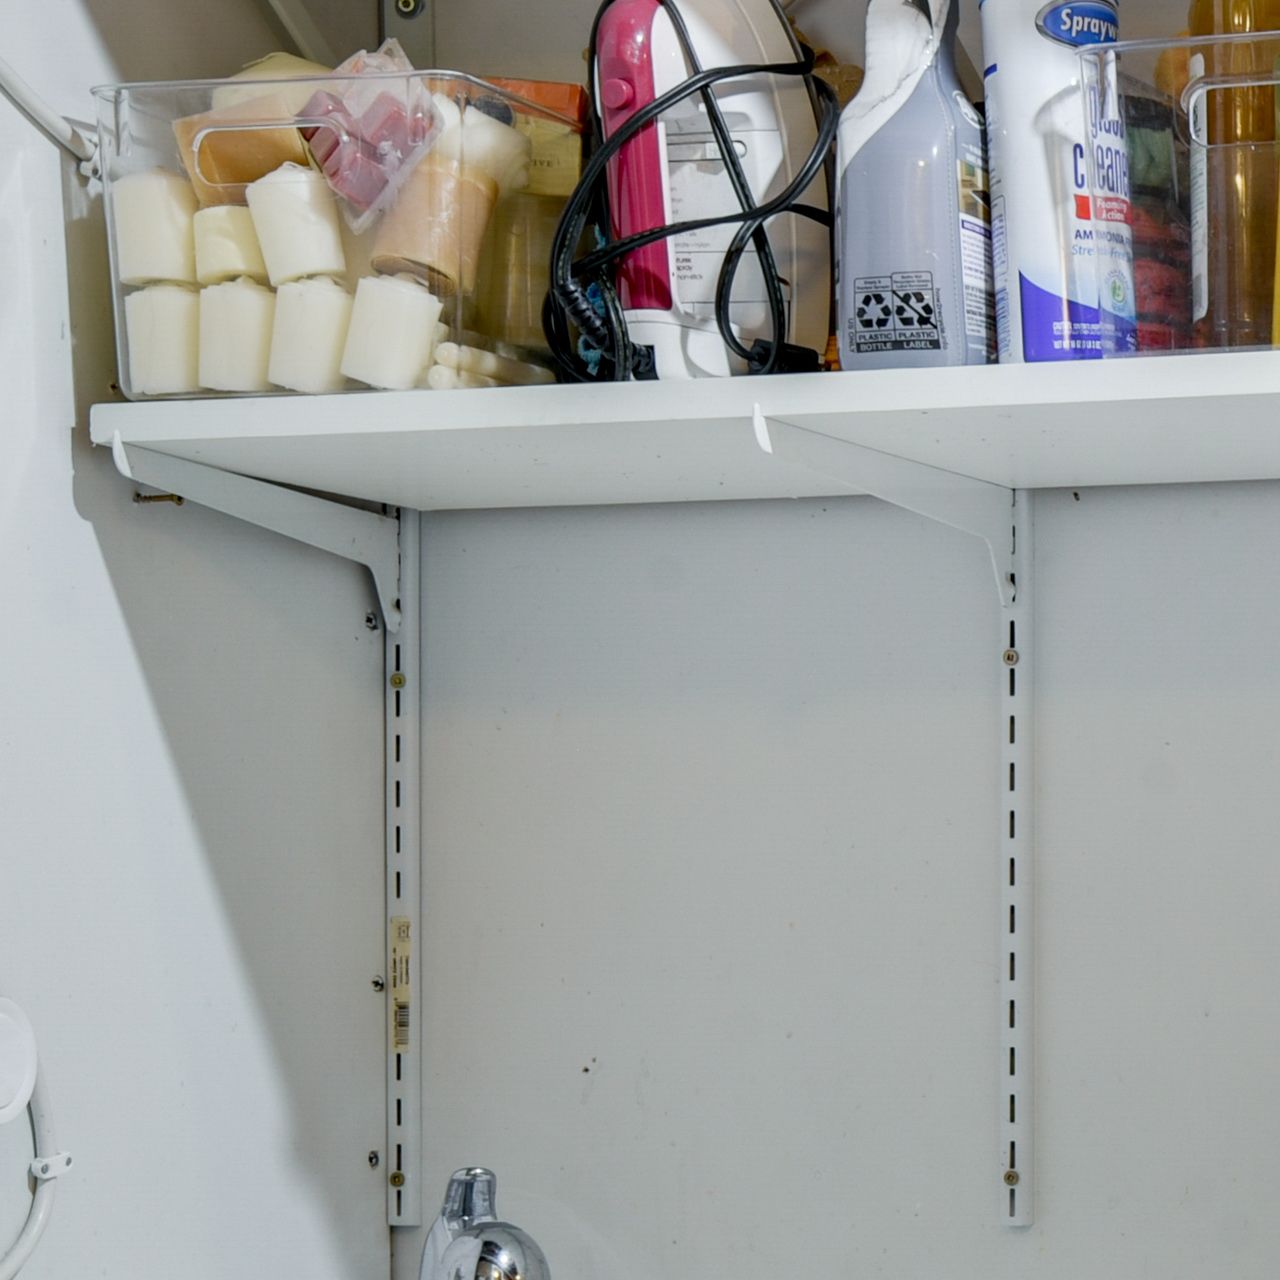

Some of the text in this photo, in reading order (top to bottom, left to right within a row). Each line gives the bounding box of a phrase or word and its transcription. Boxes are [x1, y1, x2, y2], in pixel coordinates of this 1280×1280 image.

[858, 333, 893, 341] PLASTIC
[898, 331, 936, 340] PLASTIC
[860, 341, 893, 350] BOTTLE
[903, 340, 934, 349] LABEL
